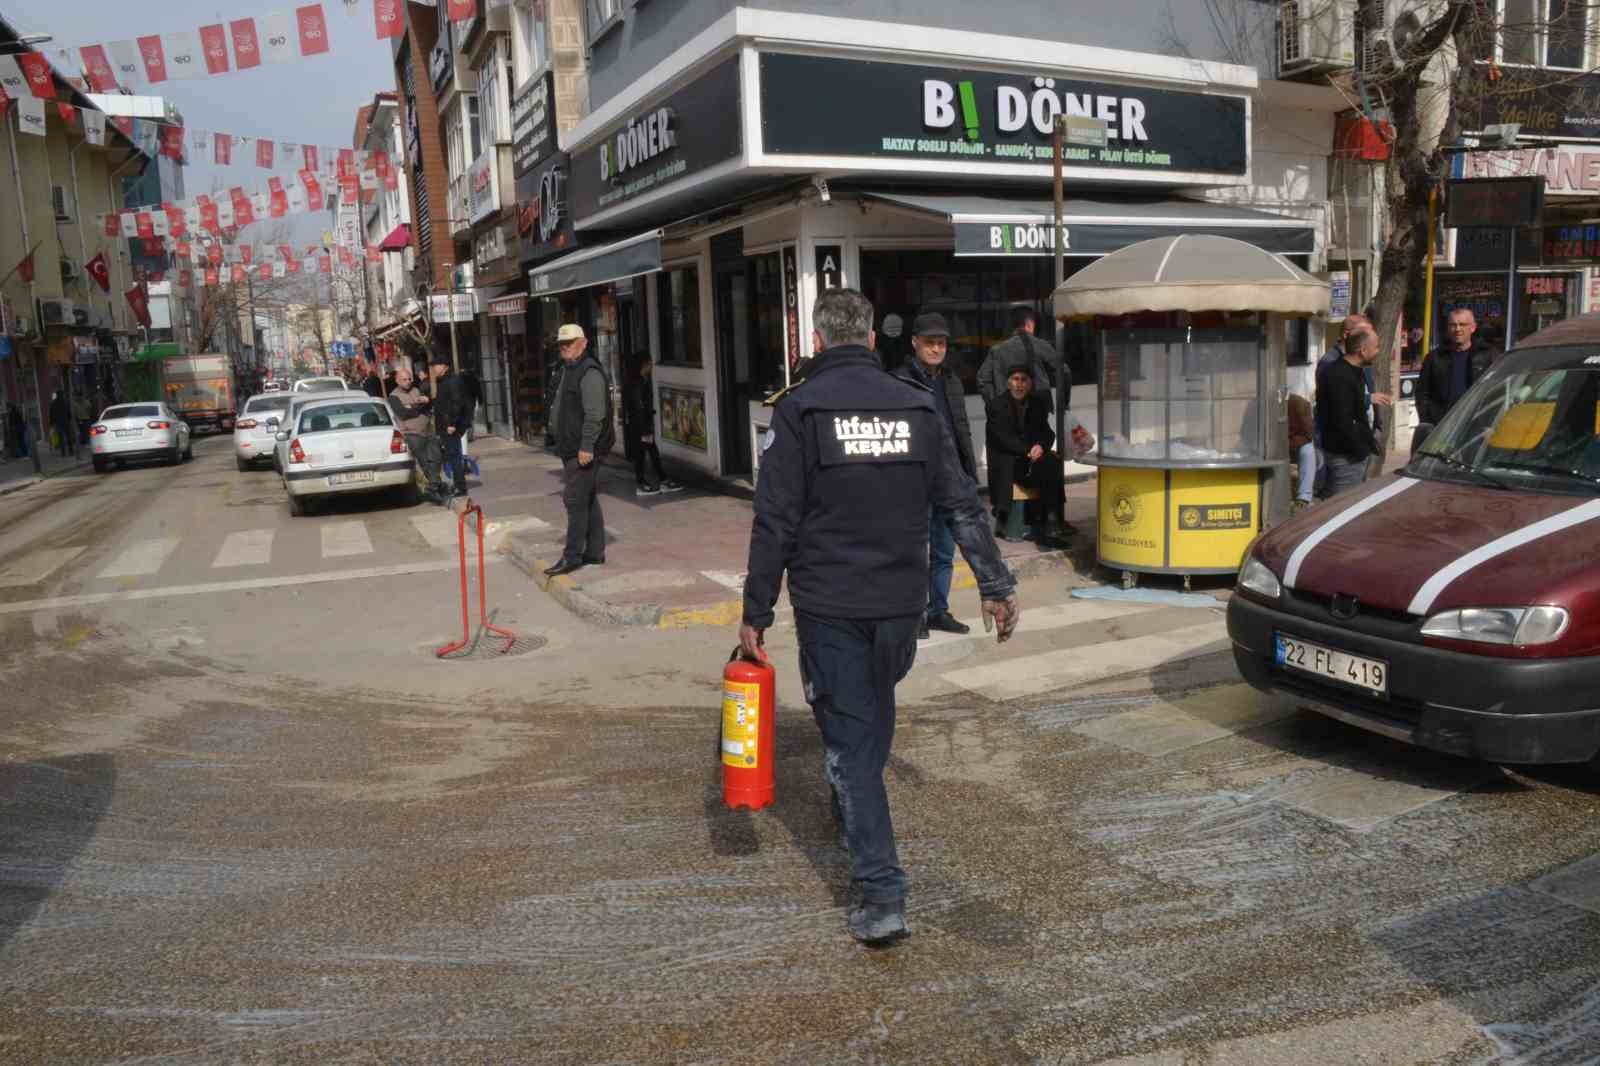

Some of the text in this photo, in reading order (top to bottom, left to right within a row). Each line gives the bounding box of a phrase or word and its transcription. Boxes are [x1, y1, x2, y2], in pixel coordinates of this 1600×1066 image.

[997, 76, 1148, 141] DÖNER
[617, 107, 672, 173] DÖNER
[882, 137, 916, 151] HATAY
[834, 416, 911, 440] itfaiye
[844, 440, 908, 457] KEŞAN
[1285, 640, 1383, 687] 22 FL 419
